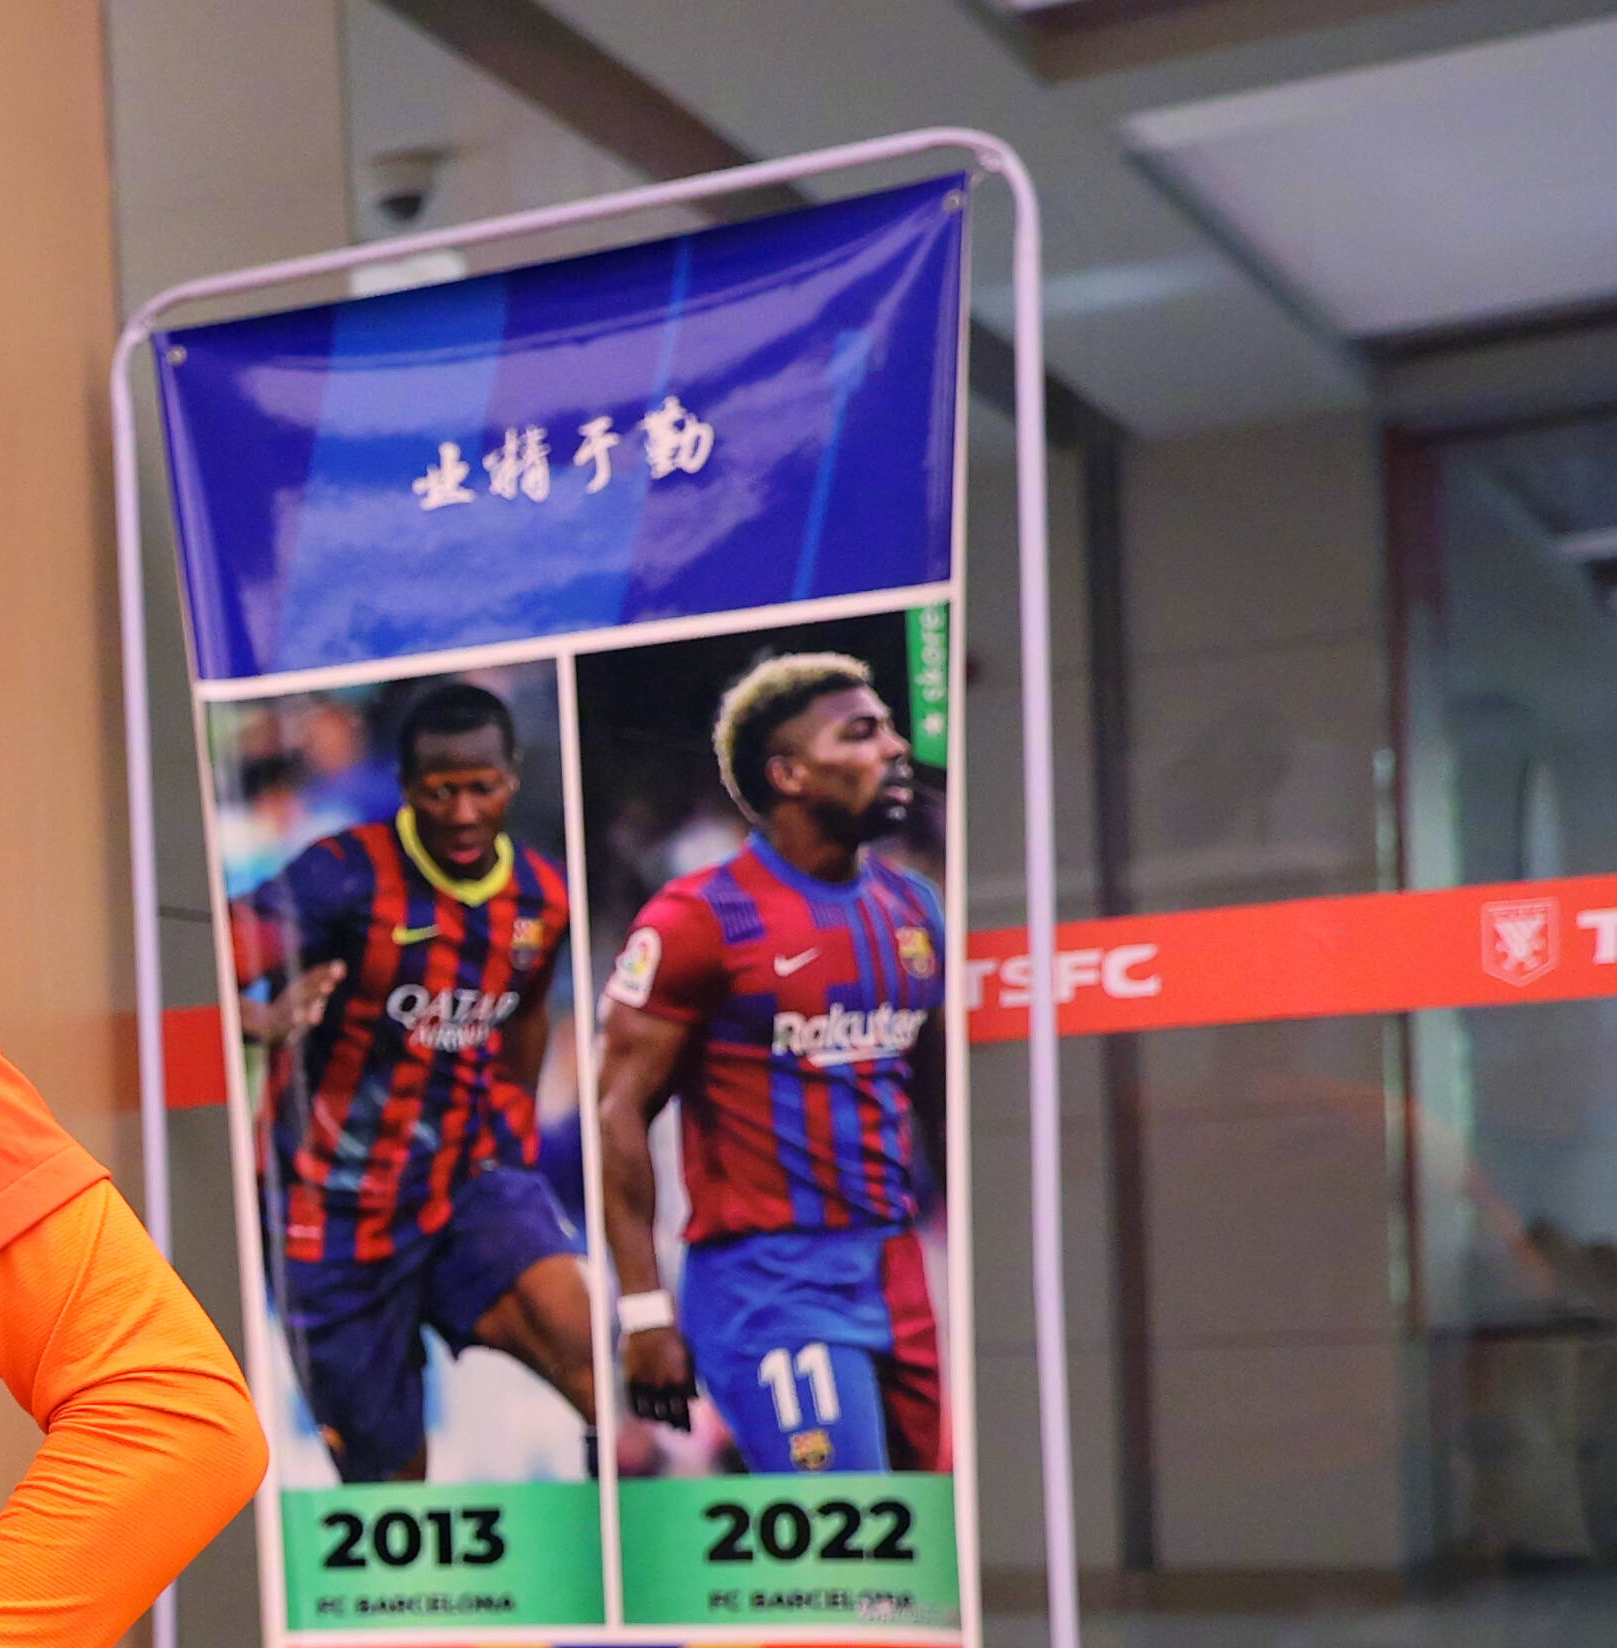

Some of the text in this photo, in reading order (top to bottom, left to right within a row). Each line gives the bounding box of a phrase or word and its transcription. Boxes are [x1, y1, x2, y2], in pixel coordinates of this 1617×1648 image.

[965, 943, 1163, 1011] TSFC
[758, 1341, 841, 1433] 11
[323, 1508, 506, 1568] 2013
[704, 1501, 915, 1562] 2022
